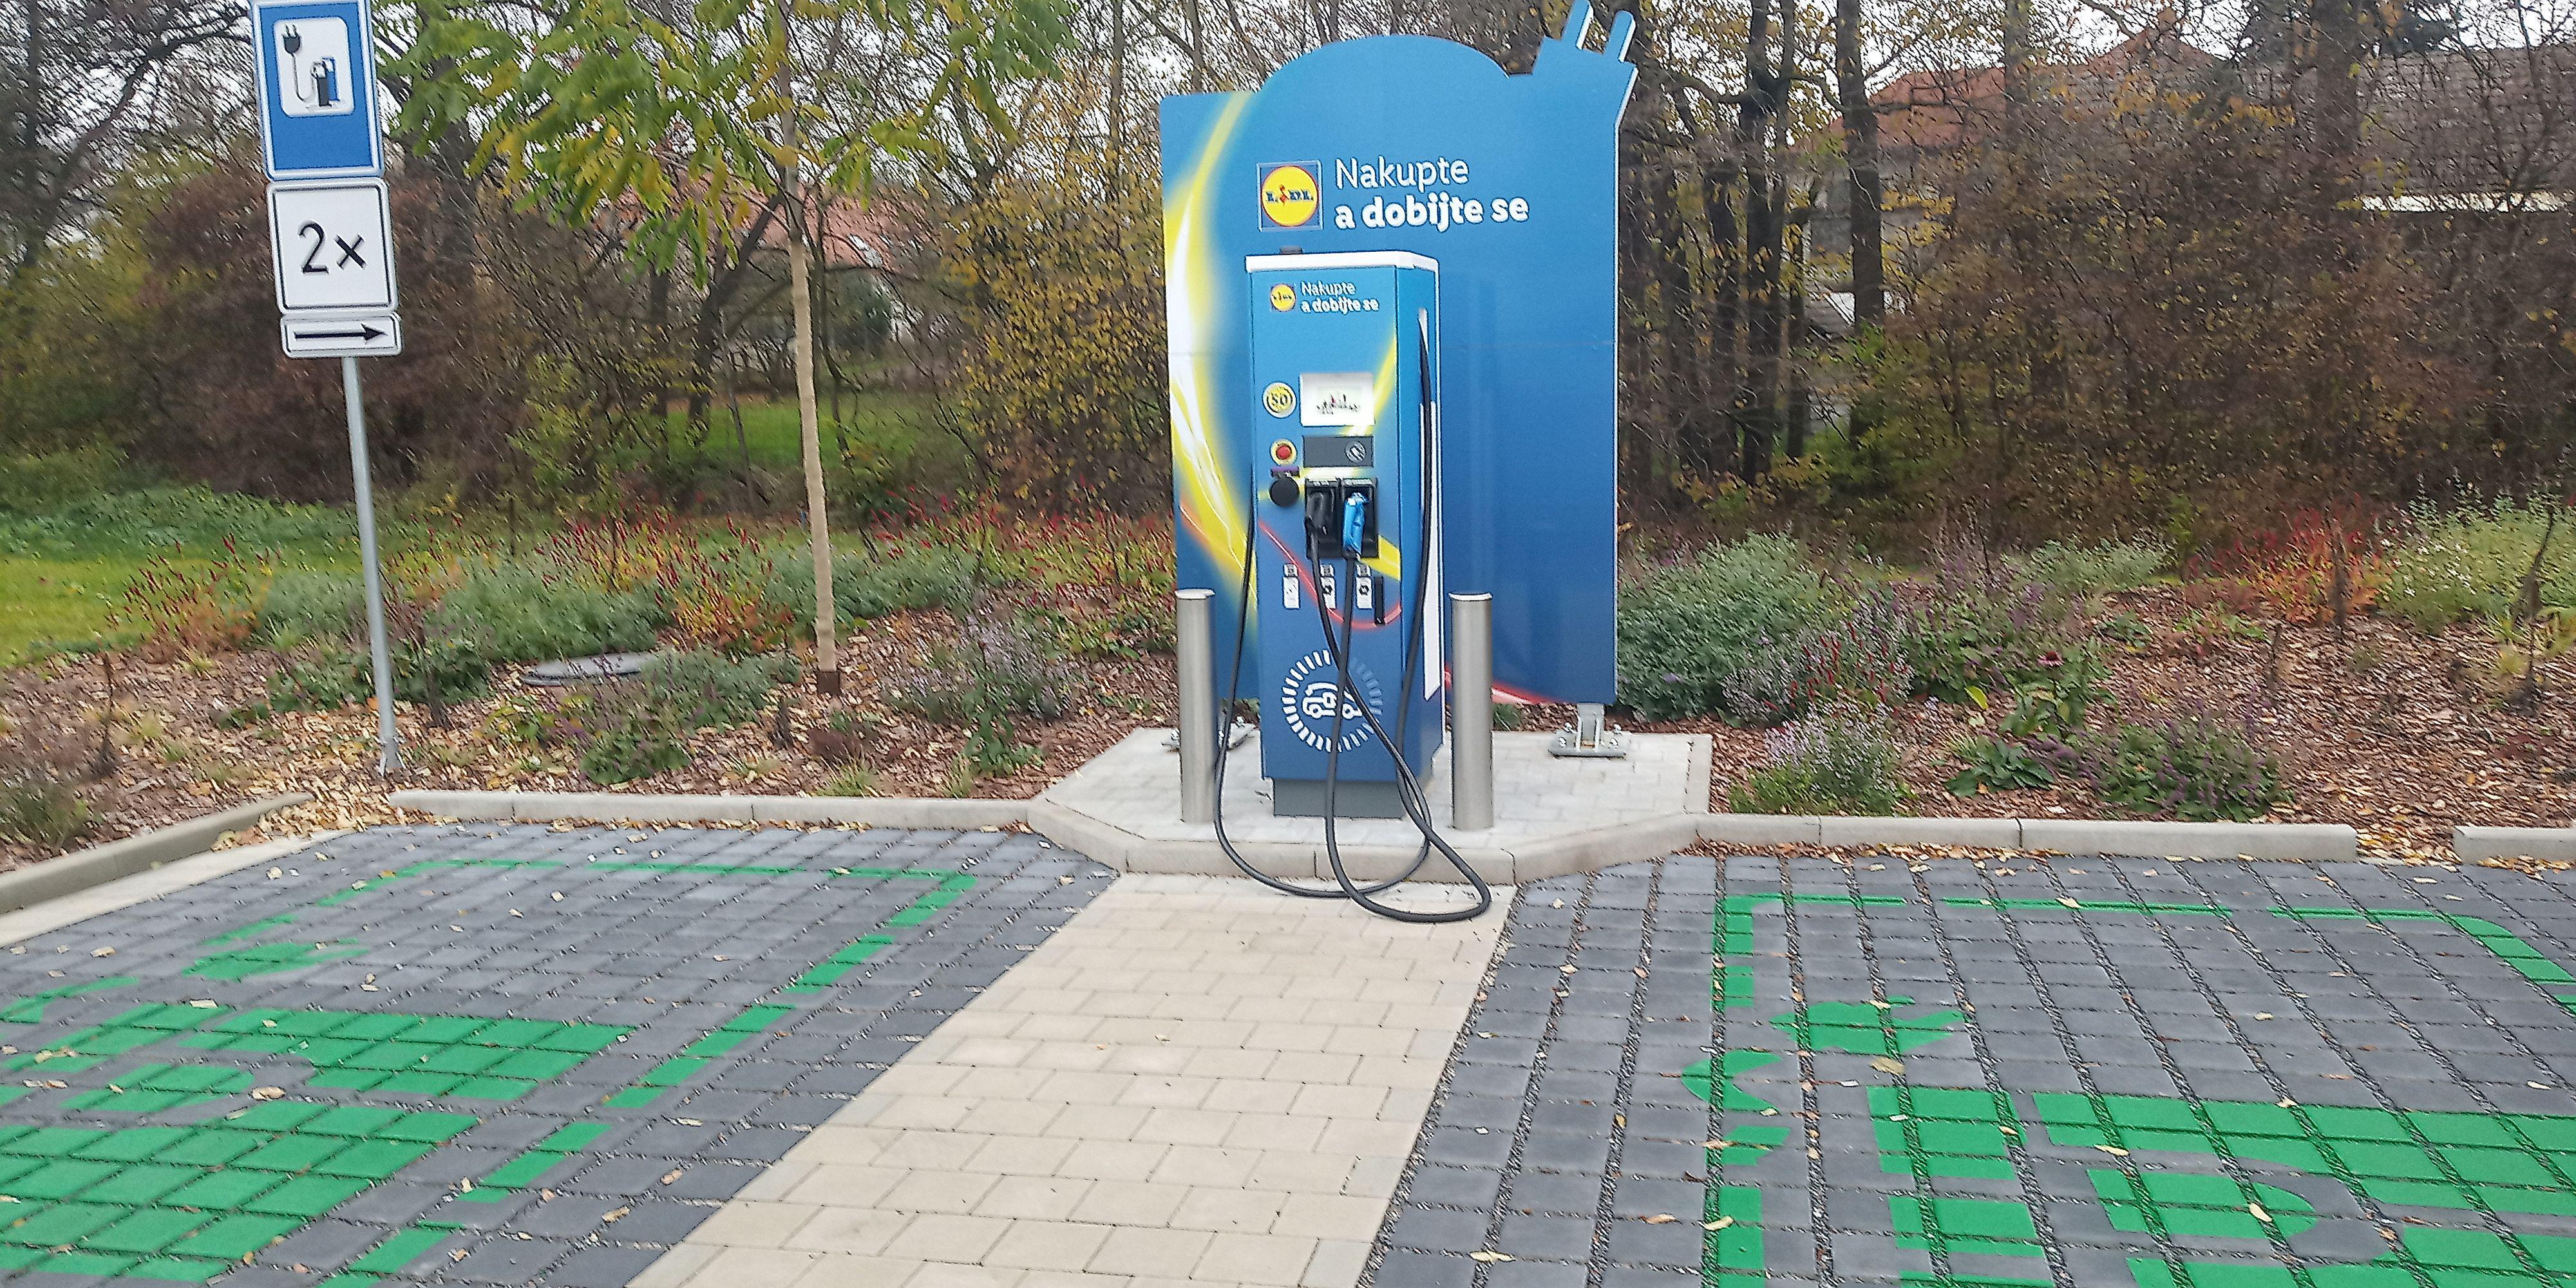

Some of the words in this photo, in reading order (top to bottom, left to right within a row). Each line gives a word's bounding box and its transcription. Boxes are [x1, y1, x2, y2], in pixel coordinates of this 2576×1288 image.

[1336, 155, 1469, 193] Nakupte
[1335, 204, 1356, 229] a
[1361, 191, 1483, 232] dobijte
[1491, 196, 1530, 223] se
[1301, 281, 1356, 297] Nakupte
[1300, 300, 1311, 313] a
[1312, 297, 1361, 315] dobijte
[1362, 298, 1379, 312] se
